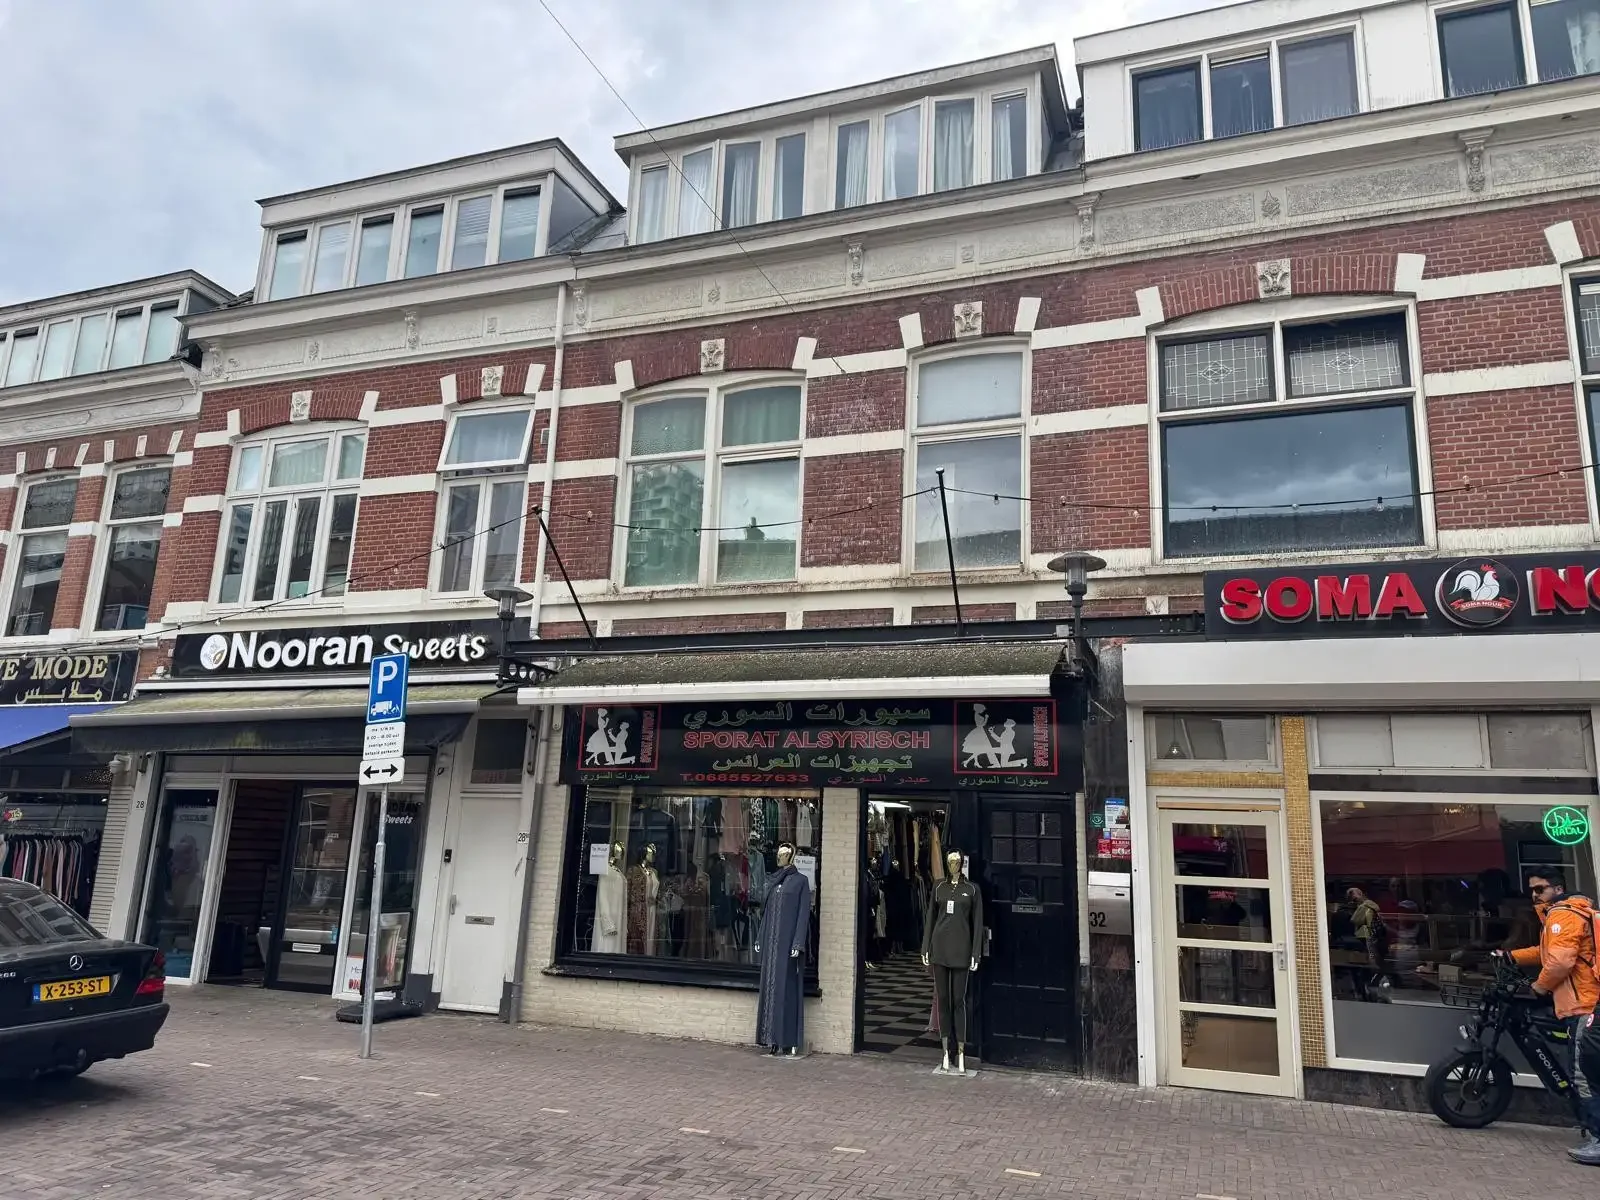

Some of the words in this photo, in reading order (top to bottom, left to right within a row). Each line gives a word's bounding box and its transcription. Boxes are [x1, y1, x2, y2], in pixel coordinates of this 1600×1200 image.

[1221, 572, 1428, 624] SOMA
[1530, 565, 1600, 617] N
[1461, 601, 1480, 609] SOMA
[228, 632, 373, 669] Nooran
[383, 633, 486, 662] Sweets
[0, 658, 20, 681] E
[30, 655, 109, 680] MODE
[377, 660, 398, 694] P
[15, 680, 103, 704] ملابس
[683, 701, 793, 730] السوري
[684, 730, 780, 749] SPORAT
[783, 730, 931, 749] ALSYRISCH
[713, 752, 801, 772] العرائس
[810, 753, 913, 773] تجهيزات
[135, 800, 145, 809] 28
[1552, 826, 1584, 837] HALAL
[1089, 911, 1107, 928] 32
[45, 978, 104, 999] X-253-ST
